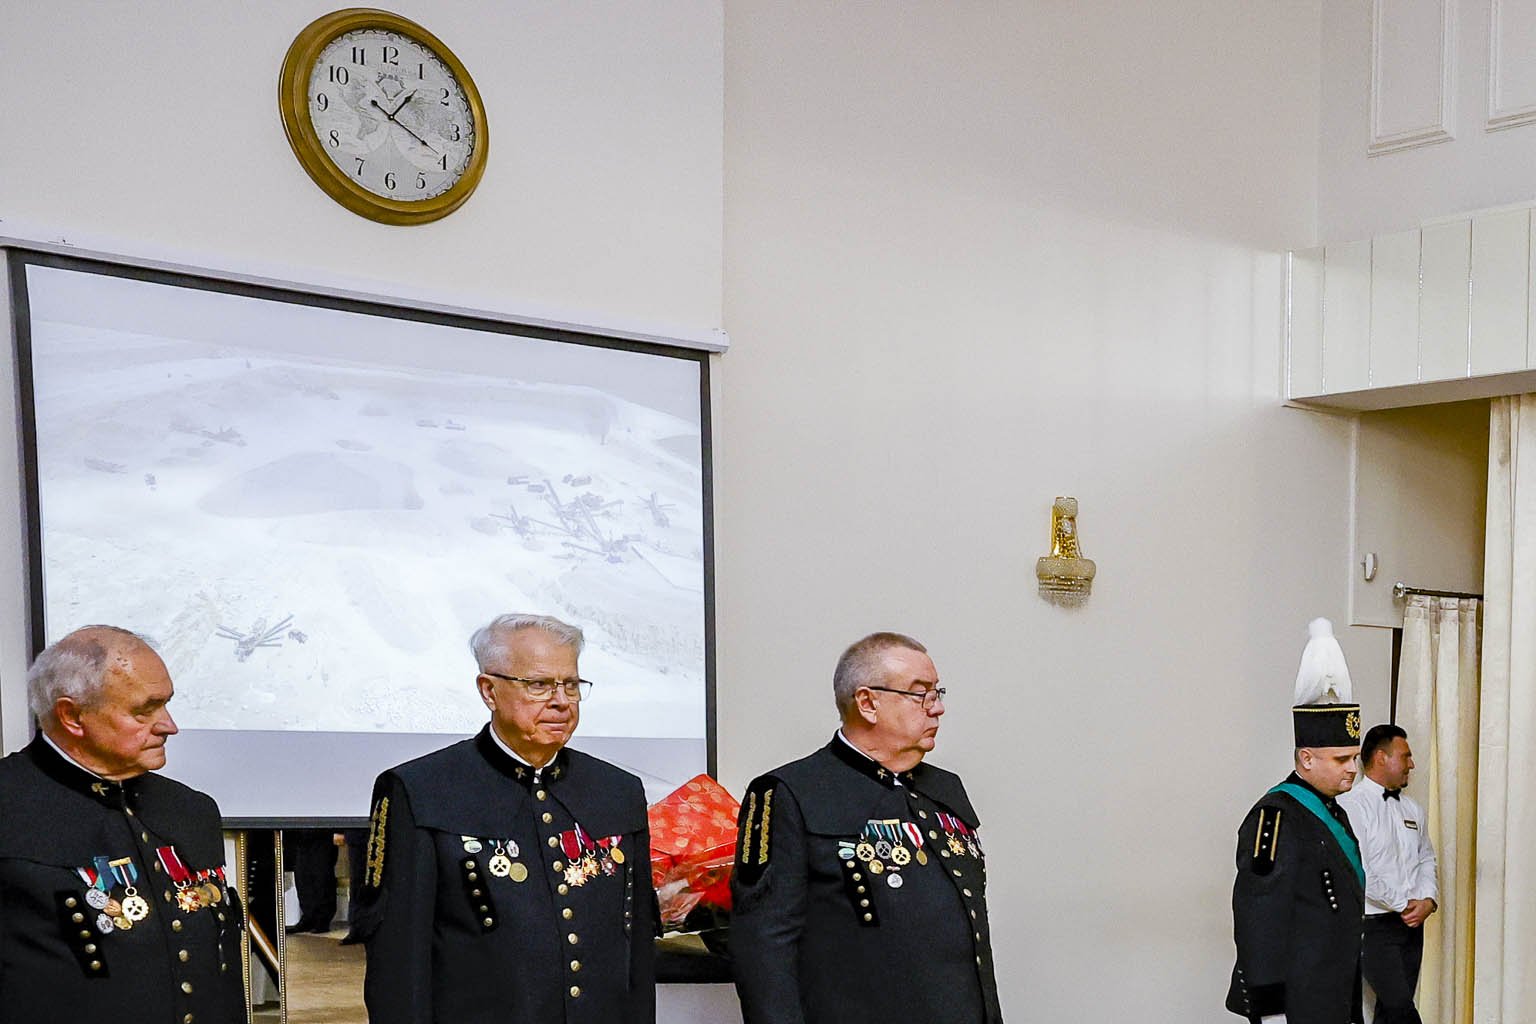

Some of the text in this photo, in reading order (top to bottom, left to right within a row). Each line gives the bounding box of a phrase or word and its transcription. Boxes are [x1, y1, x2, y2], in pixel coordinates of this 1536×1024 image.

[352, 46, 368, 66] 11
[382, 46, 399, 66] 12
[329, 65, 349, 85] 10
[417, 63, 425, 79] 1
[316, 93, 329, 112] 9
[440, 88, 450, 106] 2
[329, 130, 340, 148] 8
[450, 124, 460, 142] 3
[355, 157, 365, 176] 7
[437, 154, 447, 171] 4
[384, 172, 396, 190] 6
[415, 172, 426, 190] 5
